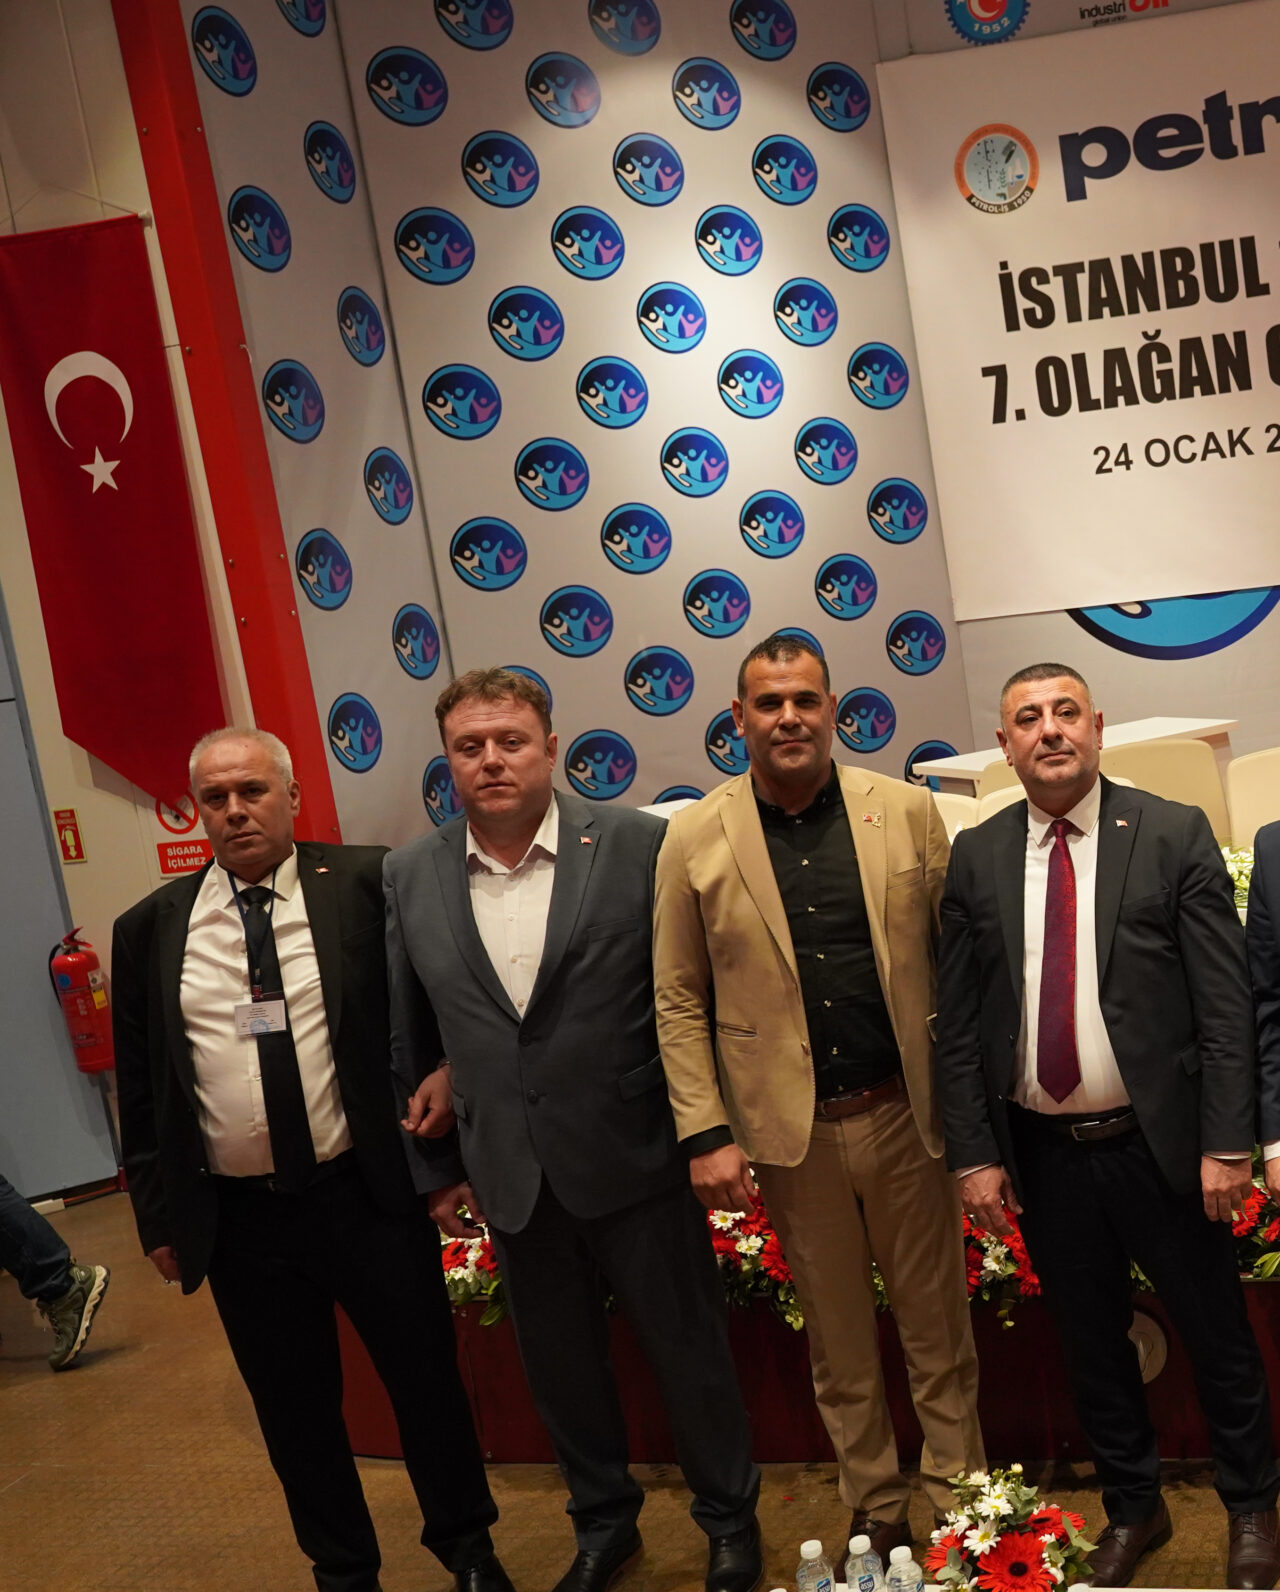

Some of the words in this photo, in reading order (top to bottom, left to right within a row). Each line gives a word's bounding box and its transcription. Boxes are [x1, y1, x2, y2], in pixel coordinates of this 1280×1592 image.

[998, 235, 1271, 332] İSTANBUL
[981, 364, 1026, 424] 7.
[1035, 330, 1253, 417] OLAĞAN
[1093, 443, 1133, 474] 24
[1144, 426, 1254, 467] OCAK
[166, 844, 204, 857] SİGARA
[167, 856, 207, 870] İÇİLMEZ
